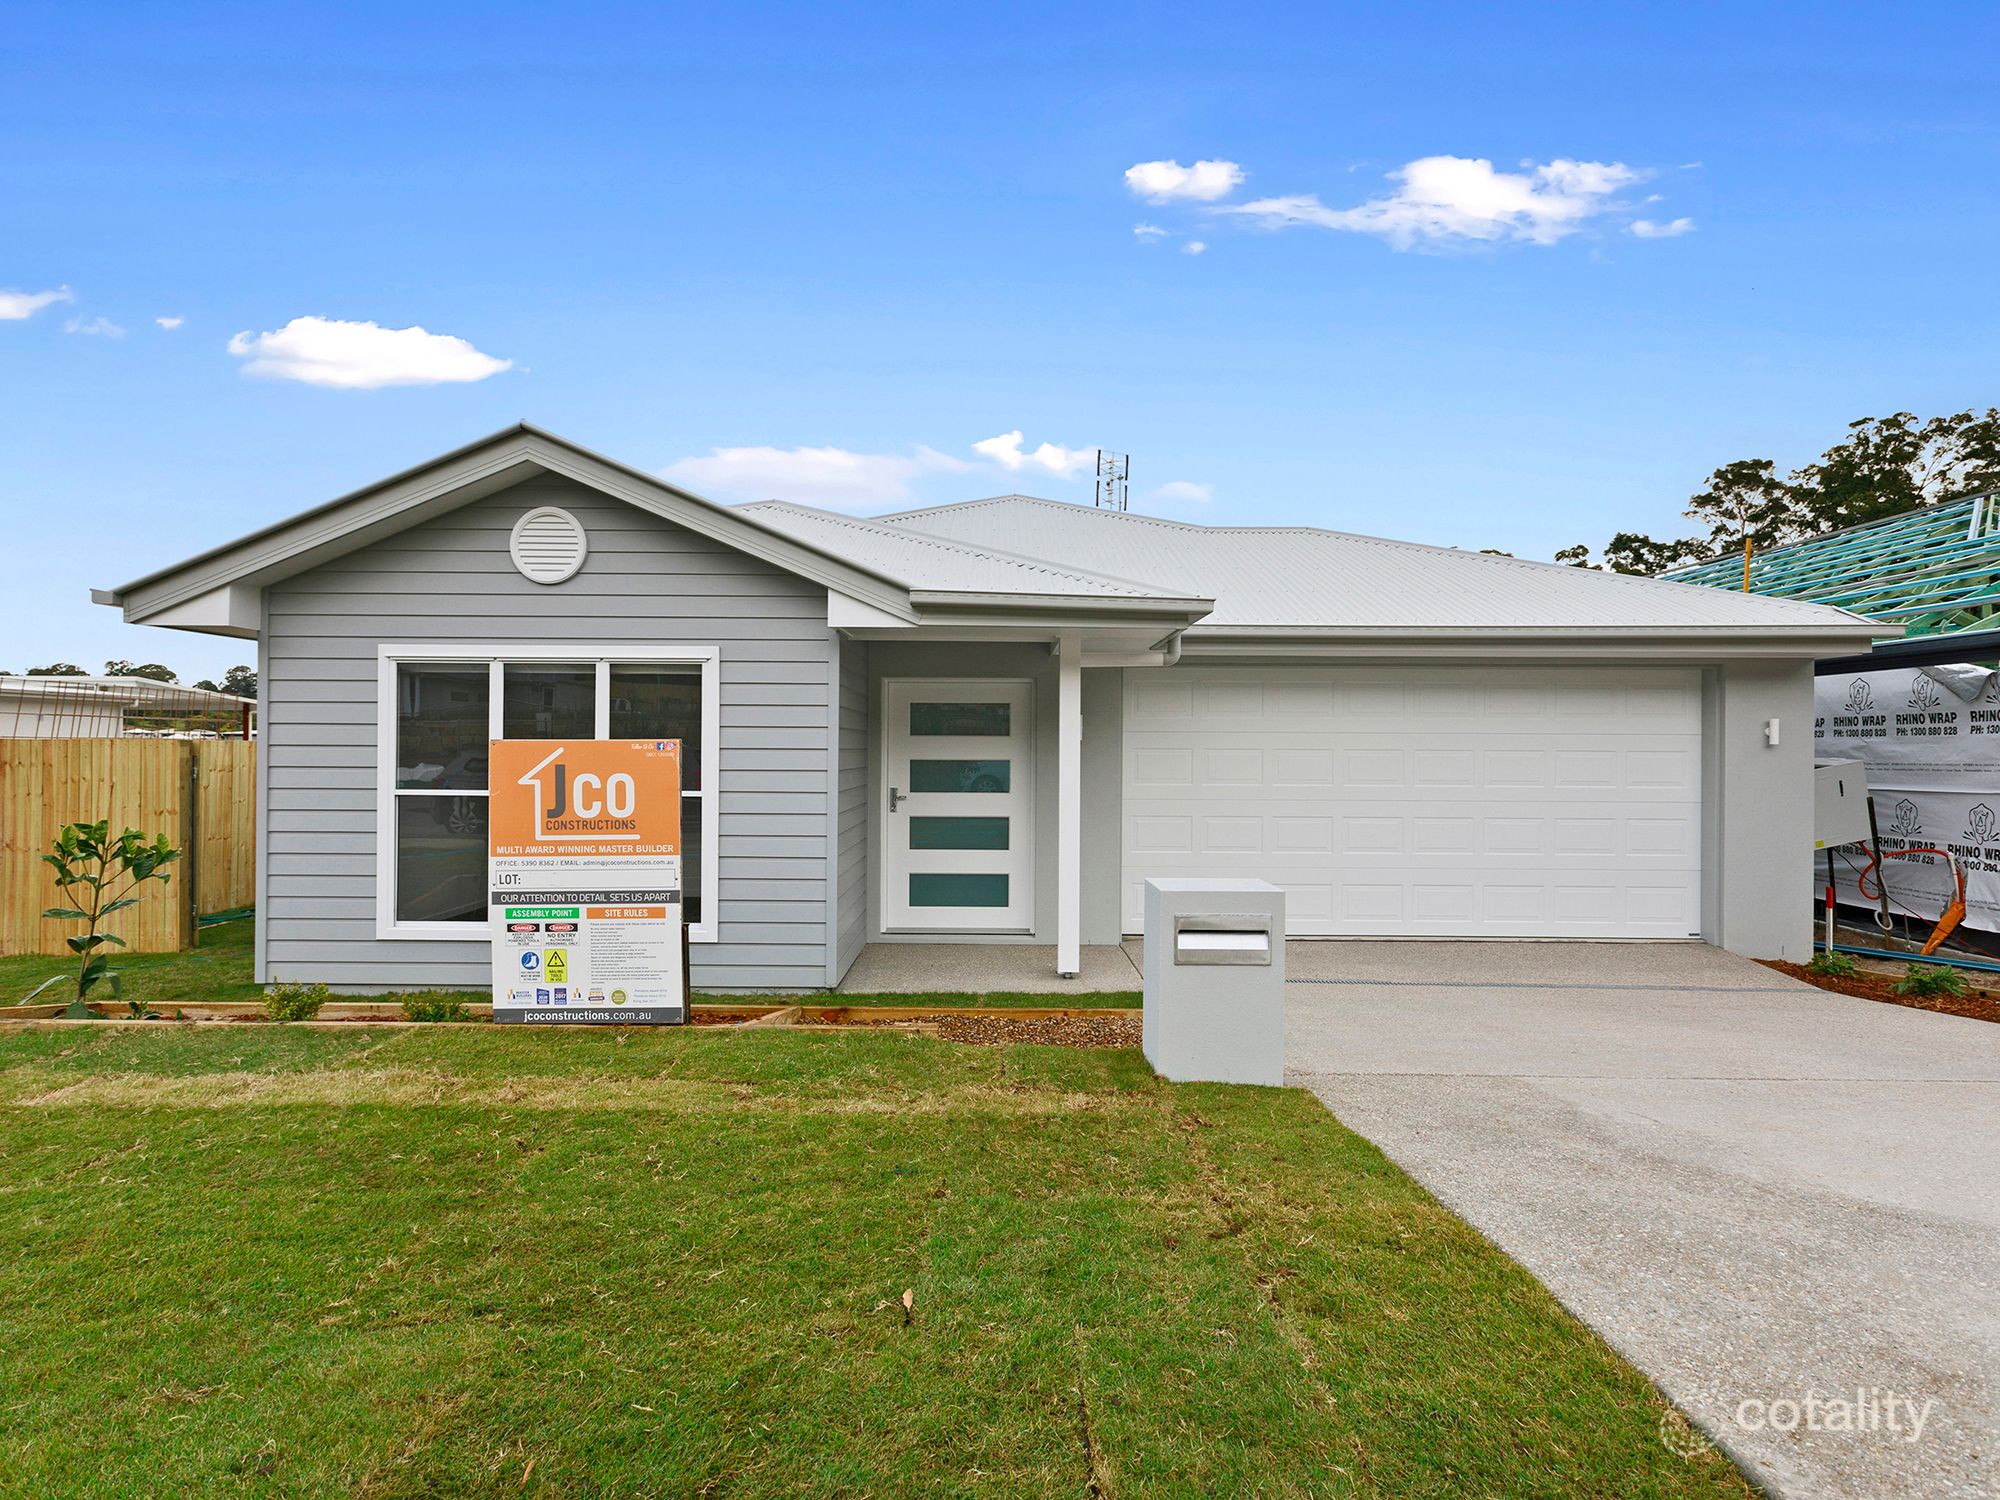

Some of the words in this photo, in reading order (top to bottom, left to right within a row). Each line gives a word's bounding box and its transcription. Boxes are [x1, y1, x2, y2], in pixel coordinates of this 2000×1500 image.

[1833, 716, 1859, 727] RHINO
[1861, 715, 1887, 726] WRAP
[1896, 713, 1926, 725] RHINO
[1928, 712, 1957, 724] WRAP
[1833, 729, 1844, 737] PH:
[1845, 729, 1859, 737] 1300
[1860, 729, 1873, 737] 880
[1874, 728, 1887, 737] 828
[1896, 727, 1908, 736] PH:
[1910, 727, 1926, 736] 1300
[1928, 726, 1941, 735] 880
[1943, 726, 1958, 735] 828
[1970, 725, 1984, 735] PH:
[547, 764, 635, 818] JCO
[546, 819, 636, 831] CONSTRUCTIONS
[1878, 836, 1905, 849] RHINO
[1908, 840, 1936, 850] WRAP
[496, 845, 523, 854] MULTI
[525, 845, 556, 854] AWARD
[557, 845, 596, 854] WINNING
[598, 844, 634, 853] MASTER
[636, 844, 674, 853] BUILDER
[1947, 844, 1980, 858] RHINO
[498, 874, 521, 885] LOT:
[500, 894, 519, 902] OUR
[520, 894, 565, 902] ATTENTION
[566, 894, 578, 902] TO
[580, 893, 607, 902] DETAIL
[609, 893, 630, 902] SETS
[631, 893, 643, 902] US
[643, 892, 671, 901] APART
[512, 909, 549, 917] ASSEMBLY
[551, 909, 573, 917] POINT
[604, 909, 622, 917] SITE
[623, 909, 648, 917] RULES
[524, 1011, 651, 1022] jcoconstructions.com.au
